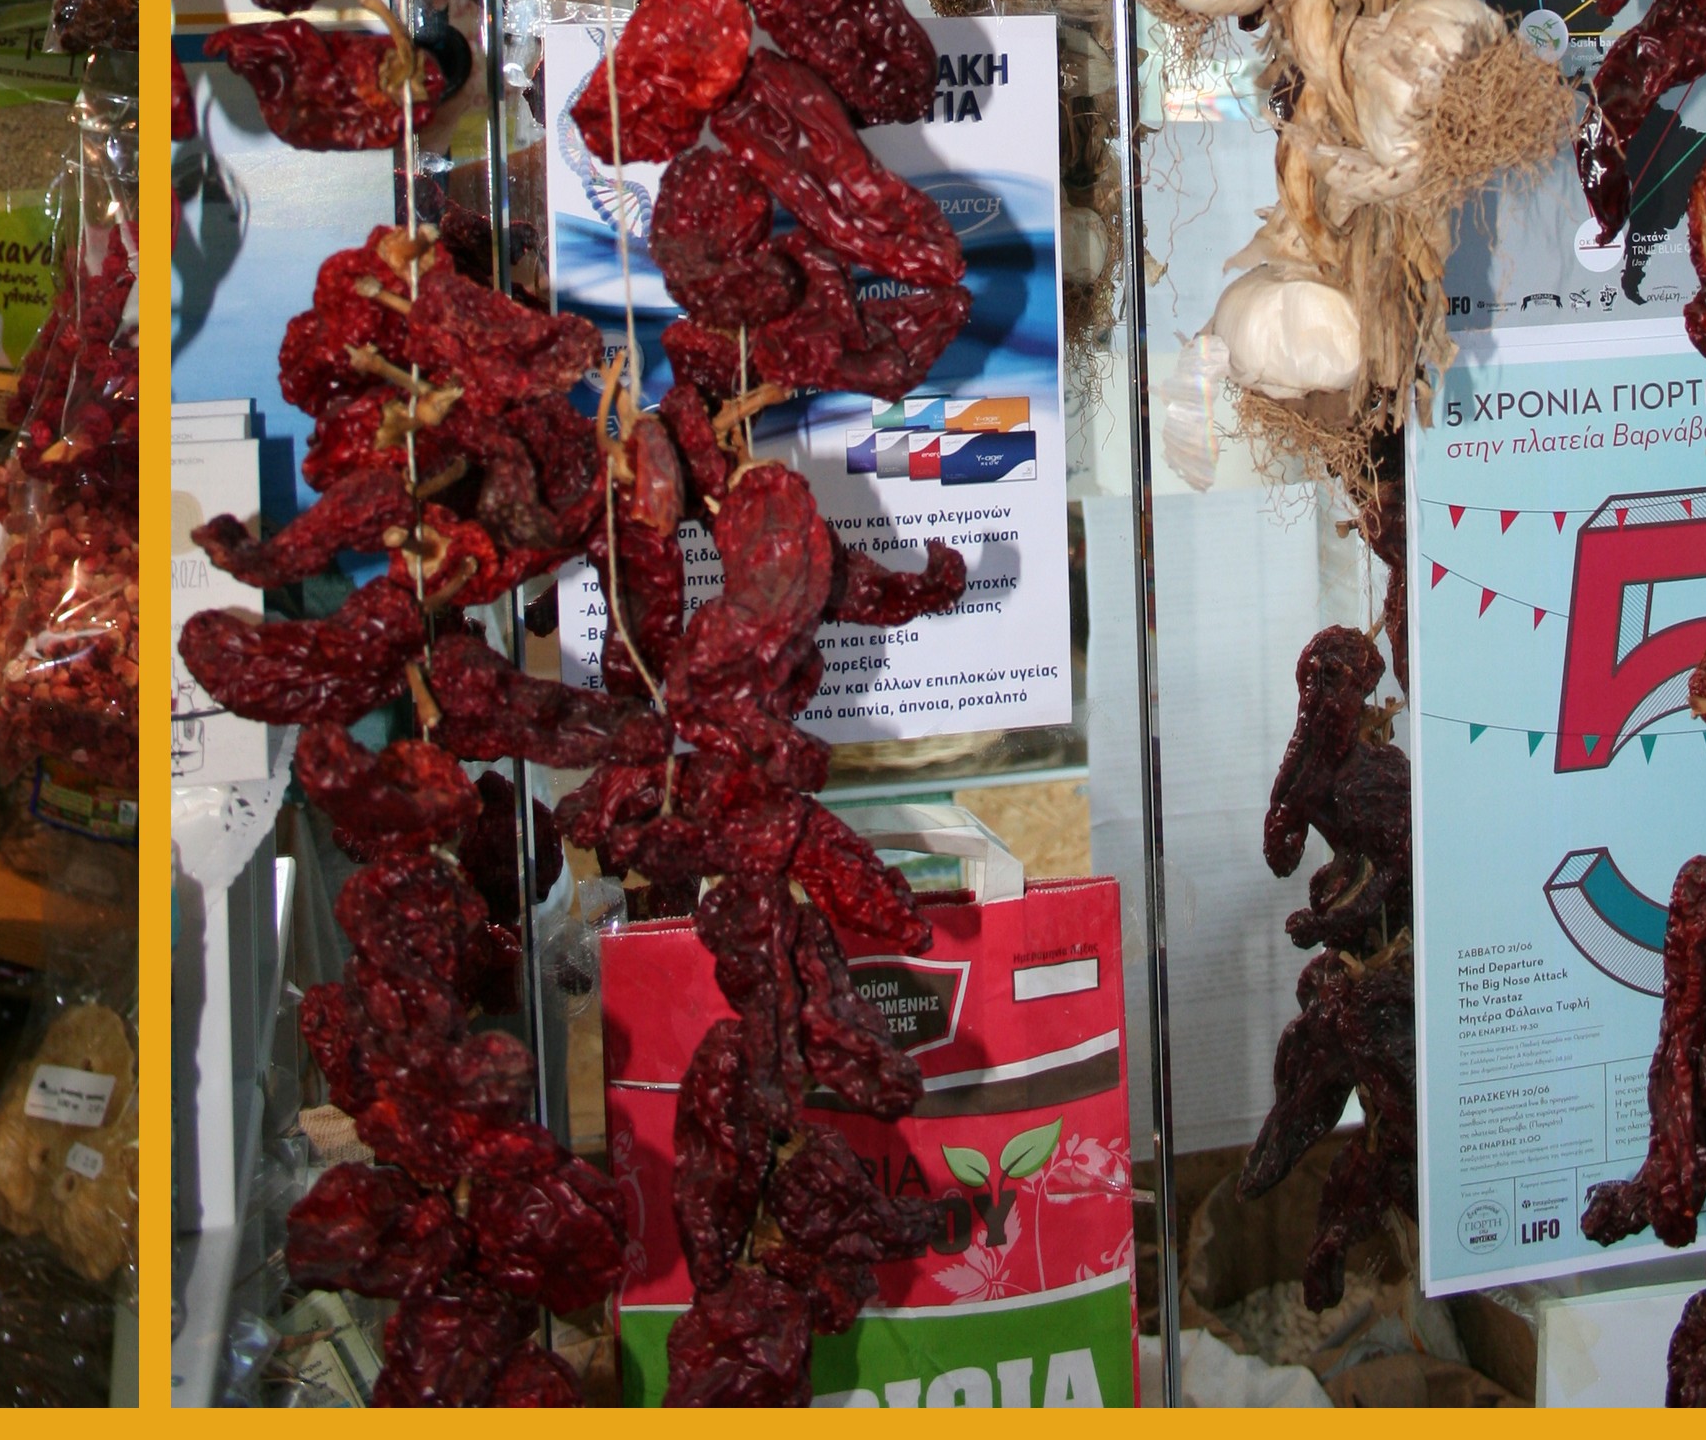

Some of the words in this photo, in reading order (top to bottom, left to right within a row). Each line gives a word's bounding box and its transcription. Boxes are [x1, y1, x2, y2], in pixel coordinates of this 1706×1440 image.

[940, 198, 1001, 215] PATCH
[1445, 400, 1463, 428] 5
[1473, 390, 1602, 422] ΧΡΟΝΙΑ
[1446, 438, 1504, 463] στην
[1511, 425, 1605, 457] πλατεία
[867, 516, 890, 527] και
[896, 514, 922, 525] των
[927, 505, 1011, 526] φλεγμονών
[952, 530, 1019, 546] ενίσχυση
[969, 575, 1017, 591] ντοχής
[841, 635, 864, 647] και
[870, 629, 919, 647] ευεξία
[846, 681, 869, 694] και
[874, 677, 922, 692] άλλων
[926, 669, 1005, 687] επιπλοκών
[1011, 664, 1058, 681] υγείας
[805, 705, 832, 721] από
[959, 690, 1027, 710] ροχαλητό
[1458, 945, 1505, 959] ΣΑΒΒΑΤΟ
[1458, 963, 1485, 976] Mind
[1489, 959, 1544, 973] Departure
[1459, 982, 1478, 992] The
[1482, 979, 1500, 991] Big
[1503, 976, 1530, 987] Nose
[1534, 968, 1568, 982] Attack
[1459, 998, 1479, 1008] The
[1483, 994, 1523, 1005] Vrastaz
[1459, 1012, 1502, 1025] Μητέρα
[1505, 1005, 1553, 1019] Φάλαινα
[1556, 997, 1590, 1012] Τυφλή
[1459, 1089, 1520, 1106] ΠΑΡΑΣΚΕΥΗ
[1523, 1086, 1550, 1097] 20/06
[1460, 1144, 1478, 1153] ΩΡΑ
[1522, 1218, 1560, 1245] LIFO
